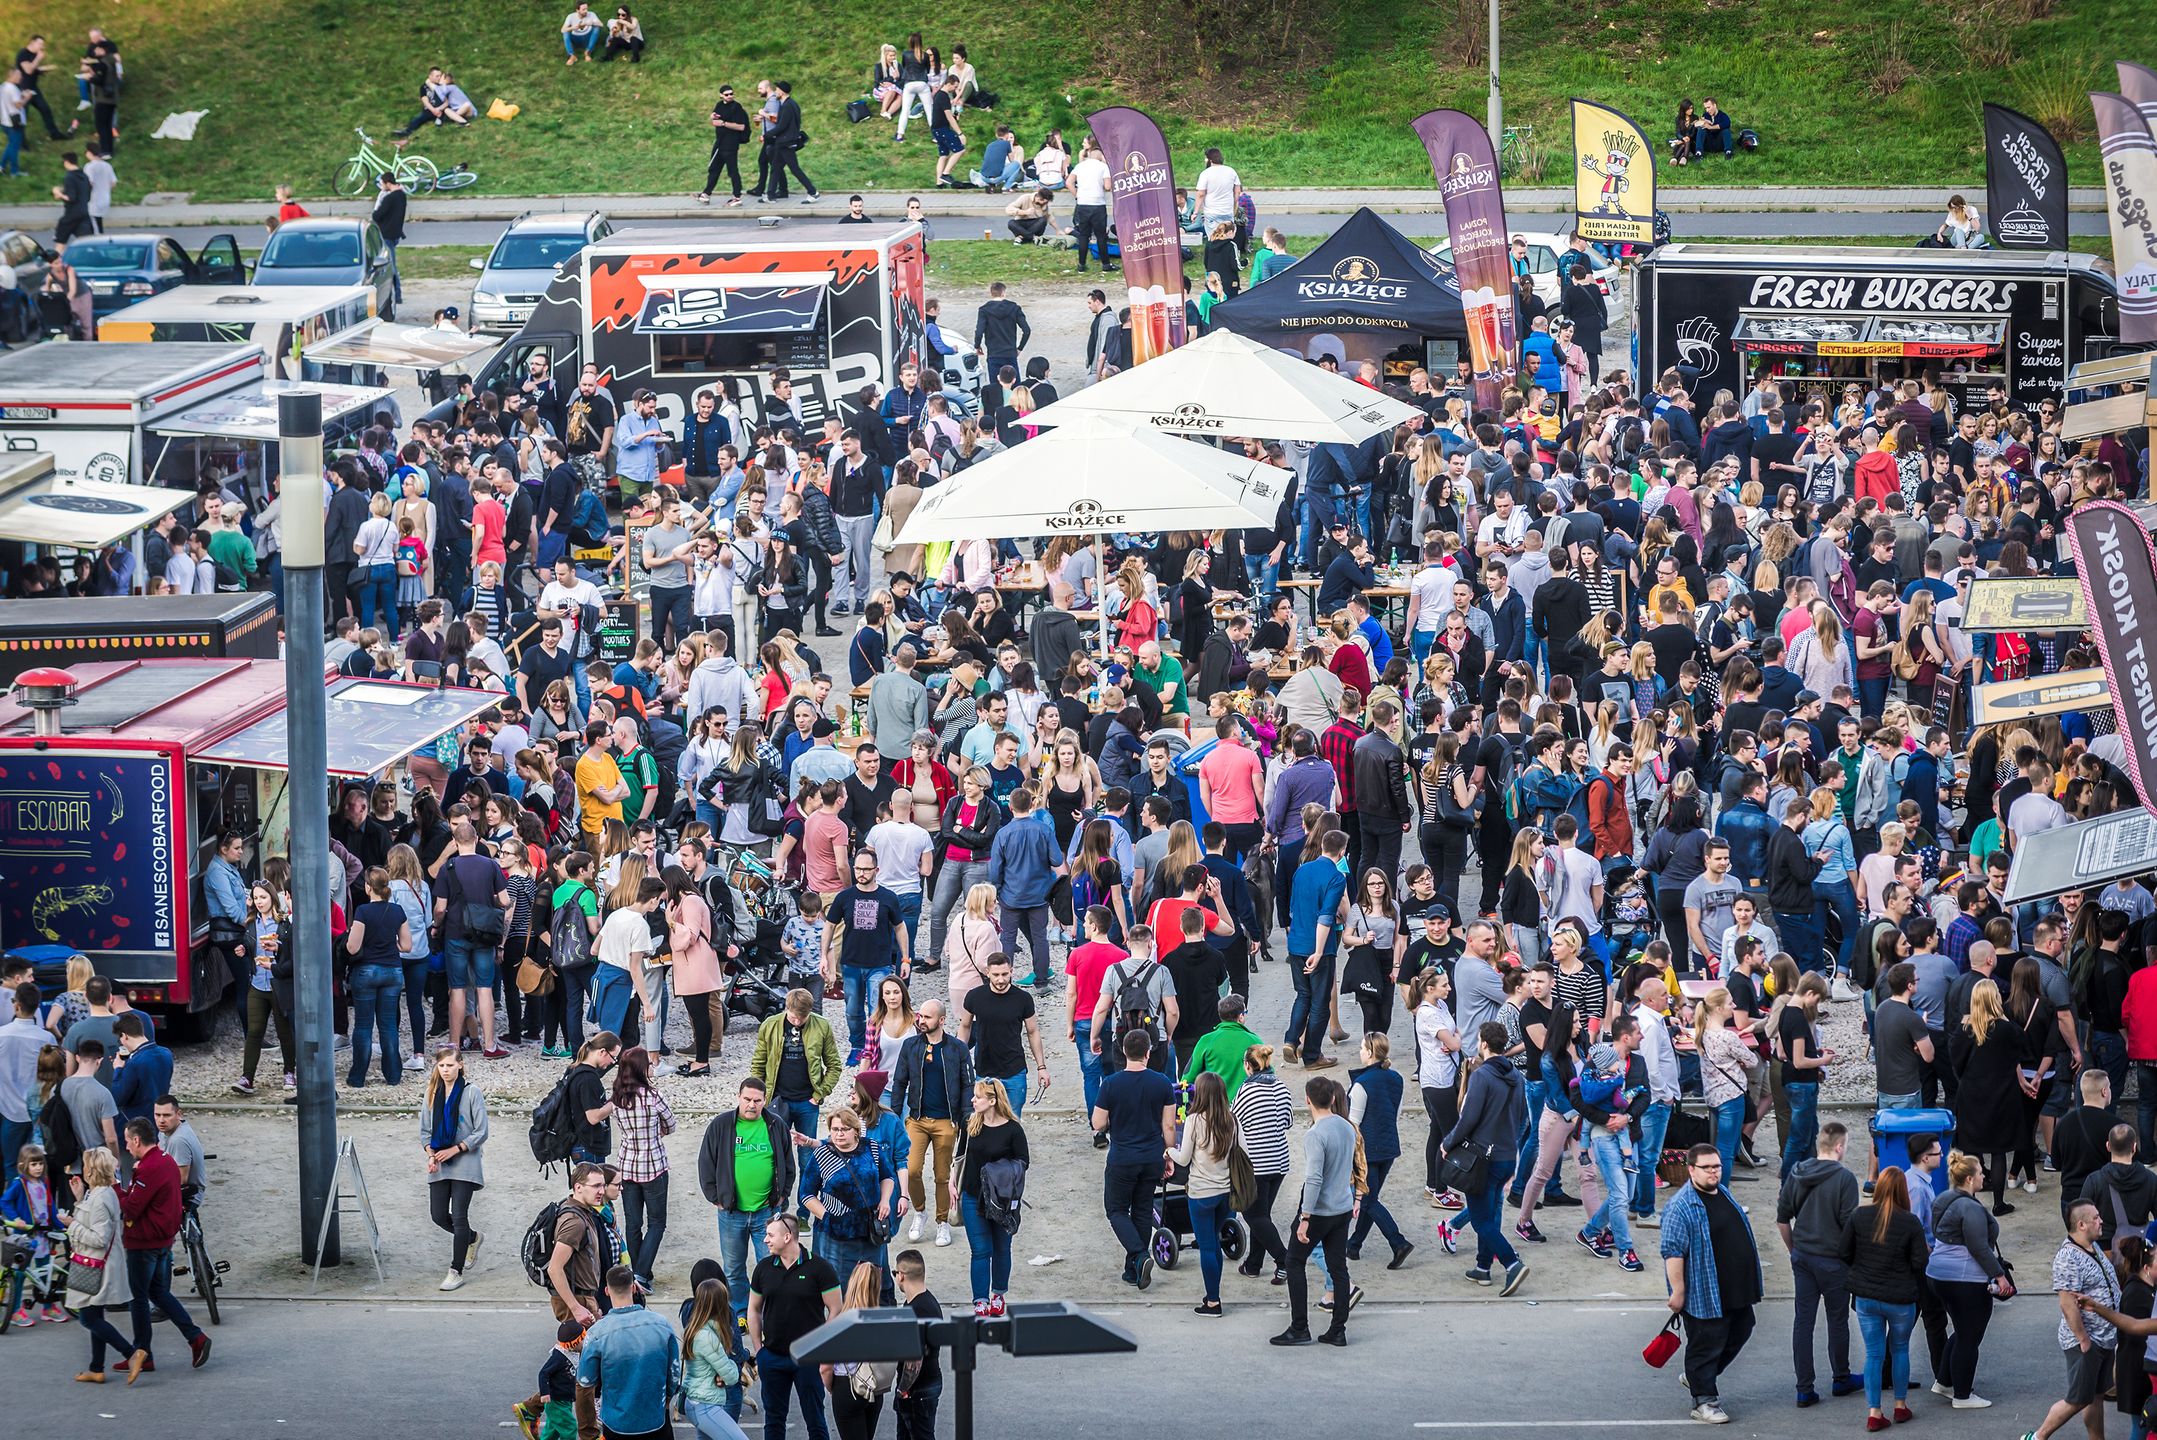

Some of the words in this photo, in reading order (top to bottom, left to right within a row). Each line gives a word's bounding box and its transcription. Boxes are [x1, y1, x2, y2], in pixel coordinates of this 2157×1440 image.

[1298, 281, 1408, 300] KSIĄŻĘCE
[1749, 275, 1855, 310] FRESH
[1860, 277, 2018, 313] BURGERS
[1280, 318, 1299, 327] NIE
[1301, 316, 1336, 327] JEDNO
[1337, 316, 1354, 325] DO
[1355, 317, 1409, 328] ODKRYCIA
[1820, 345, 1850, 354] FRYTKI
[1853, 345, 1901, 355] BELGIJSKIE
[2018, 332, 2063, 355] Super
[2021, 353, 2063, 367] żarcie
[2018, 376, 2036, 390] jest
[1150, 415, 1224, 429] KSIĄŻĘCE
[1045, 514, 1126, 529] KSIĄŻĘCE
[18, 800, 91, 831] ESCOBAR
[151, 764, 169, 930] SANESCOBARFOOD
[857, 902, 876, 910] QUIK
[736, 1143, 768, 1152] HING
